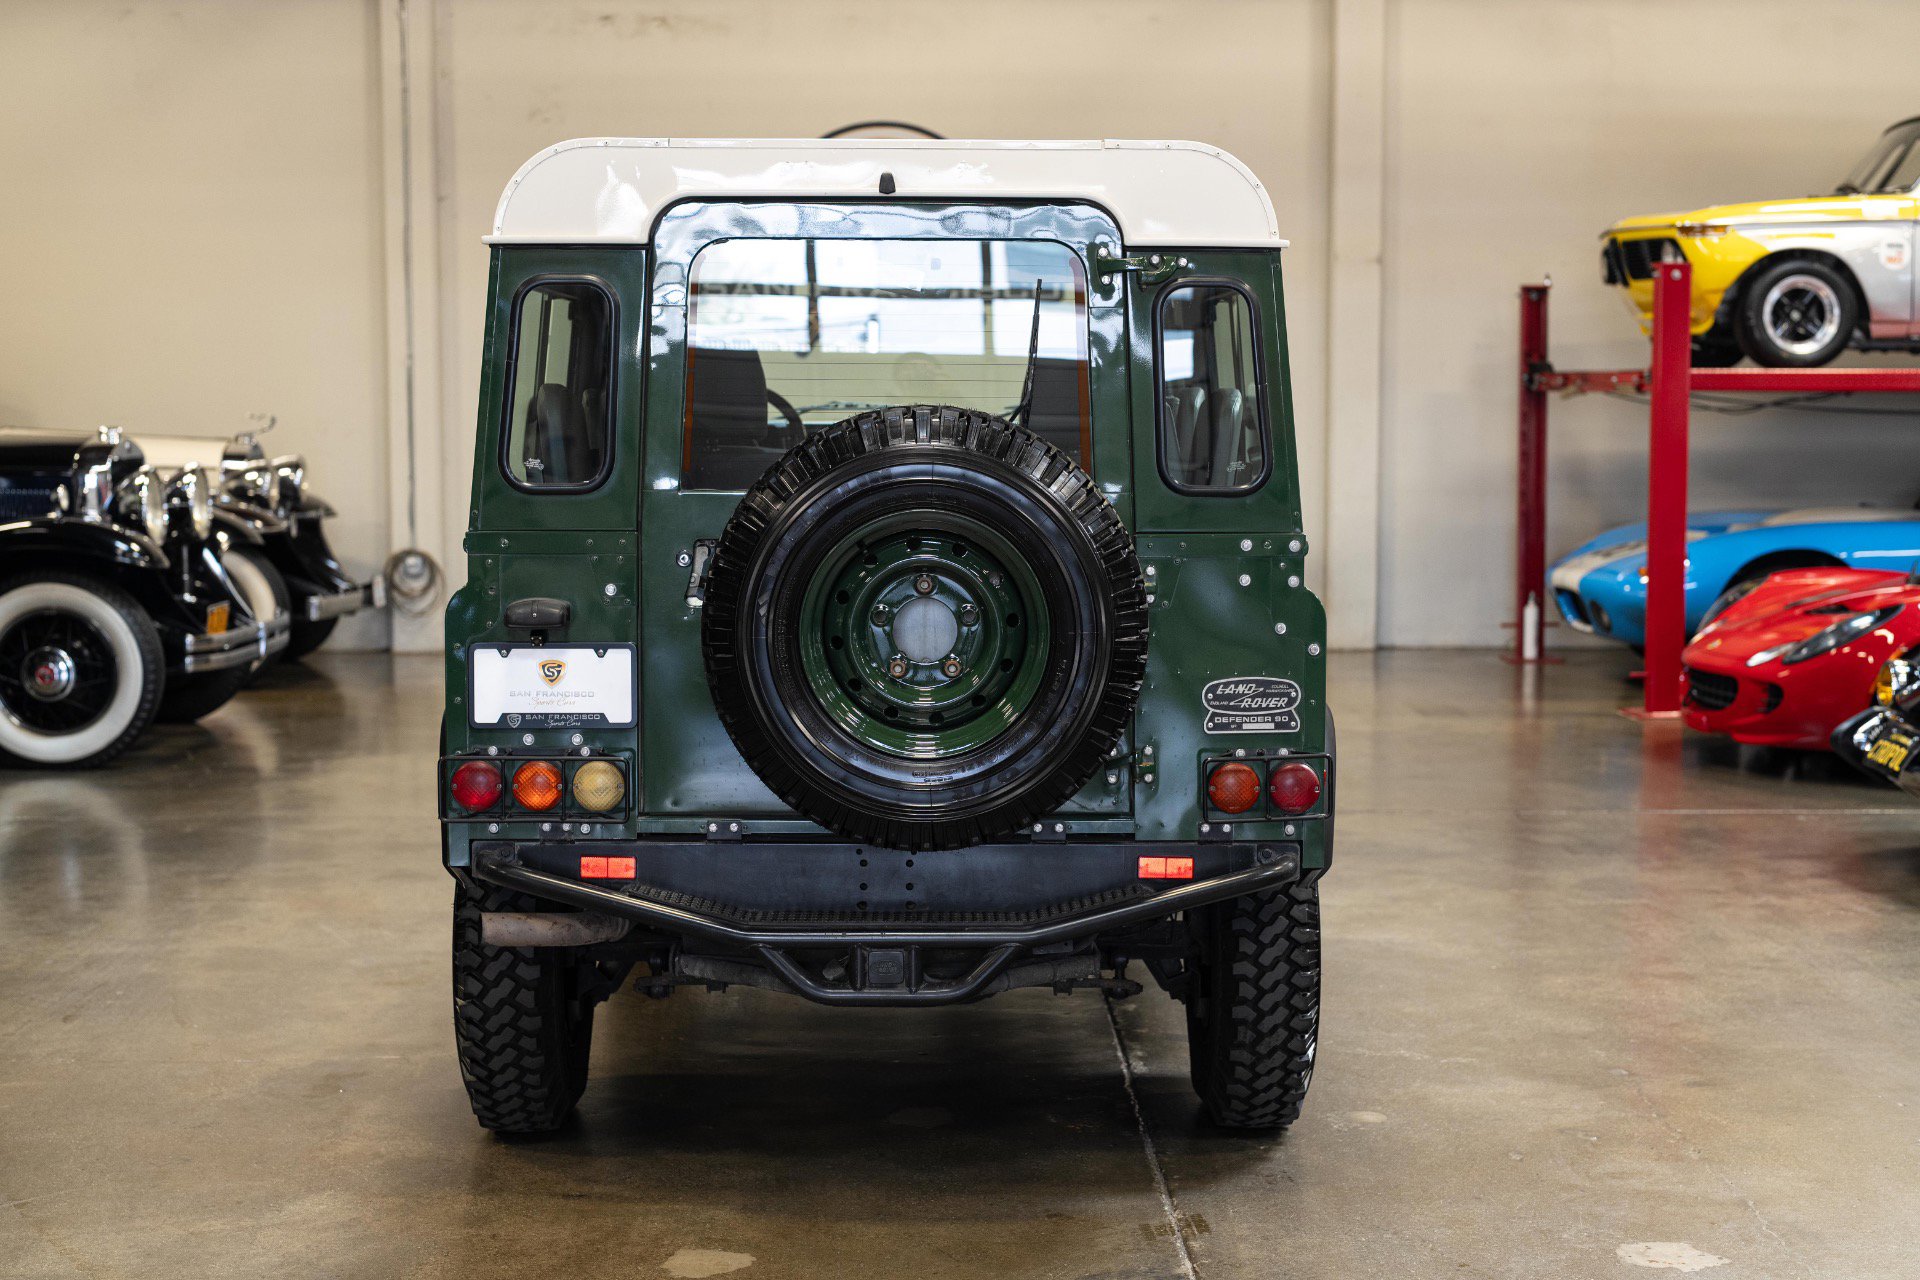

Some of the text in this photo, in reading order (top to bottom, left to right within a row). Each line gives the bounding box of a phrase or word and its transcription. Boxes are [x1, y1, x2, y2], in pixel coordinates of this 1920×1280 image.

[509, 690, 595, 698] SAN FRANCISCO
[1216, 683, 1256, 695] LAND
[1240, 697, 1288, 708] ROVER
